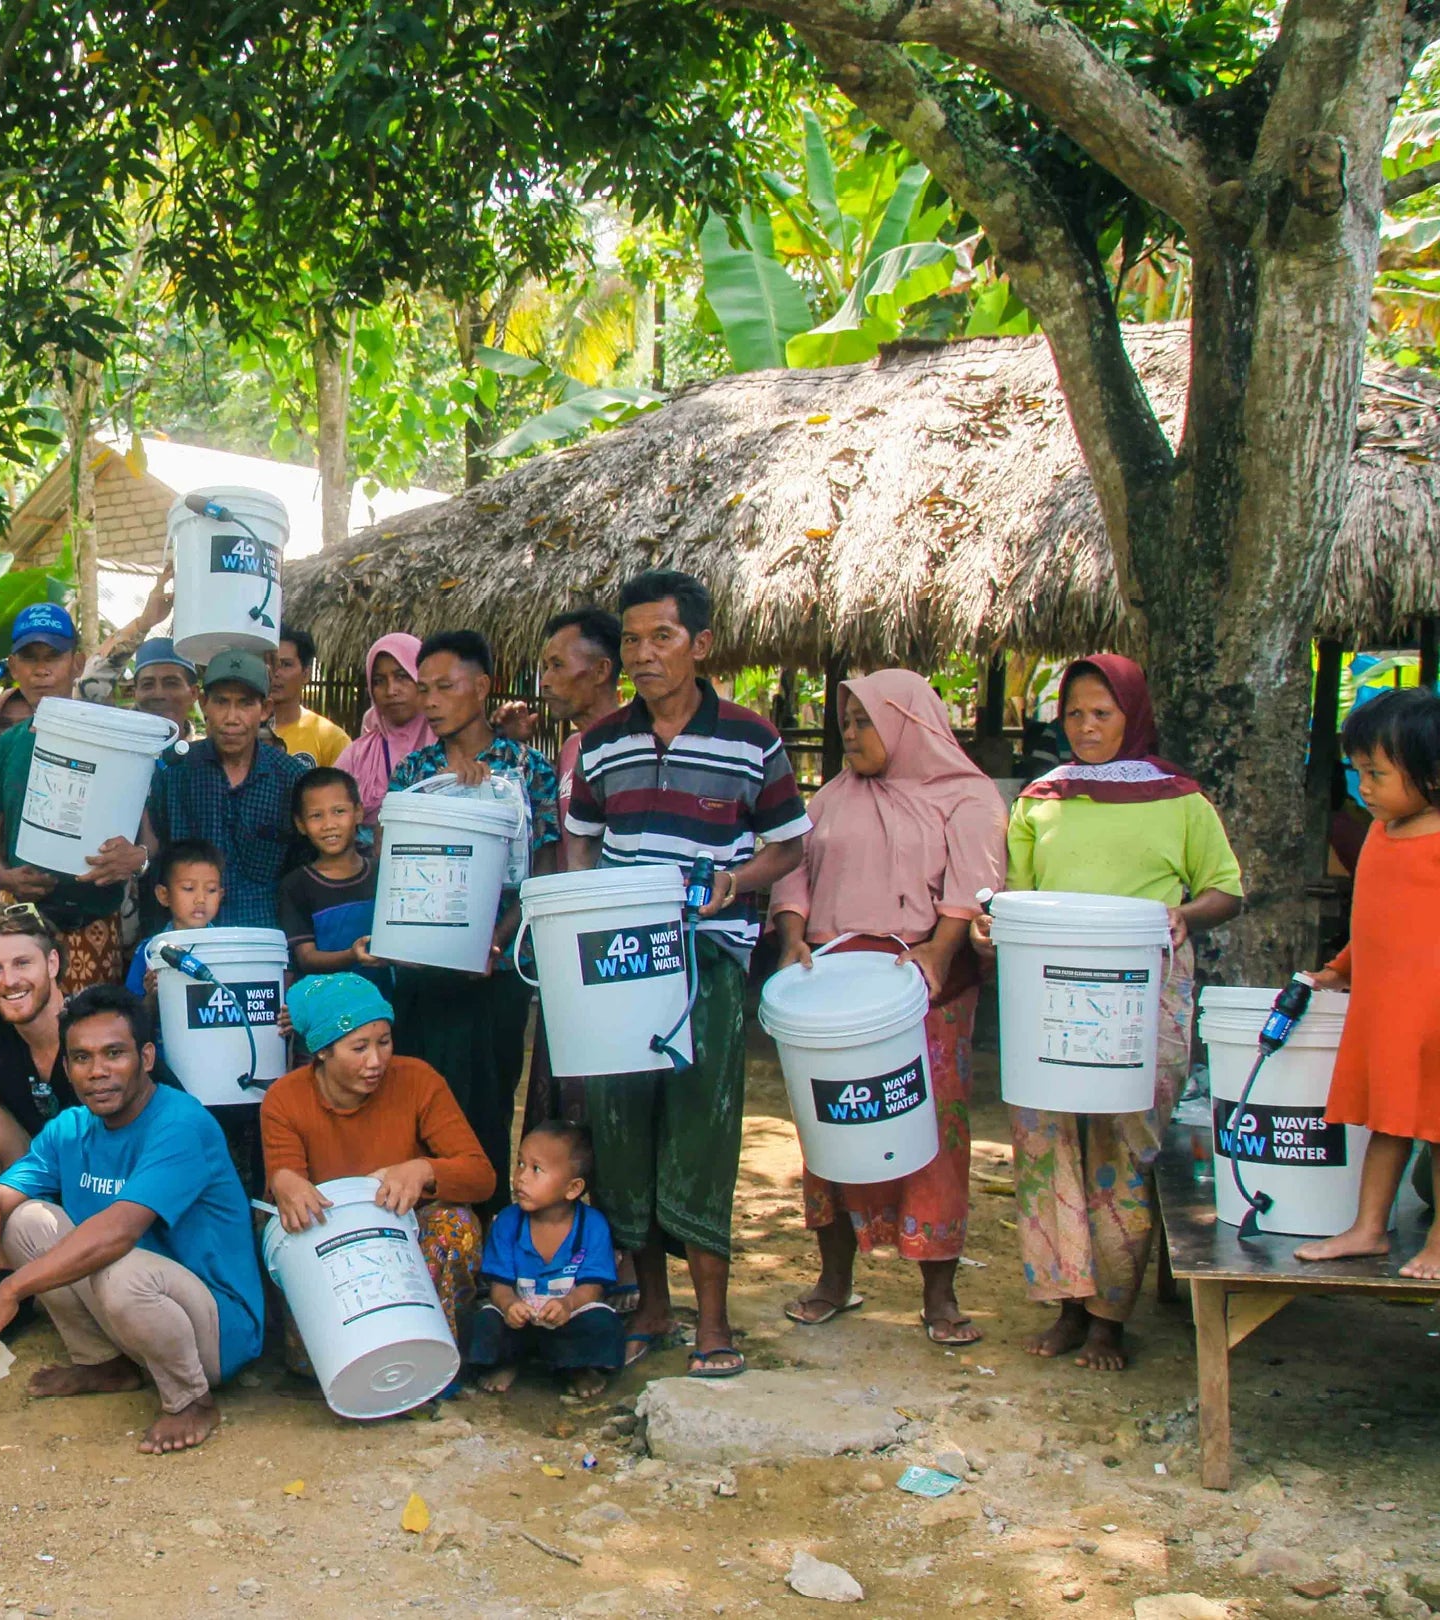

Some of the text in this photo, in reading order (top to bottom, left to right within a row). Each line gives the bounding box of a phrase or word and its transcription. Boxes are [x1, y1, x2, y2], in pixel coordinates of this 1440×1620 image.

[650, 929, 678, 945] WAVES
[652, 946, 670, 958] FOR
[653, 957, 680, 971] WATER
[246, 989, 275, 1000] WAVES
[247, 1001, 265, 1011] FOR
[247, 1011, 275, 1022] WATER
[882, 1069, 917, 1092] WAVES
[885, 1088, 907, 1104] FOR
[885, 1092, 919, 1114] WATER
[1272, 1116, 1327, 1131] WAVES
[1273, 1131, 1304, 1145] FOR
[1273, 1146, 1327, 1160] WATER
[92, 1176, 113, 1195] THE
